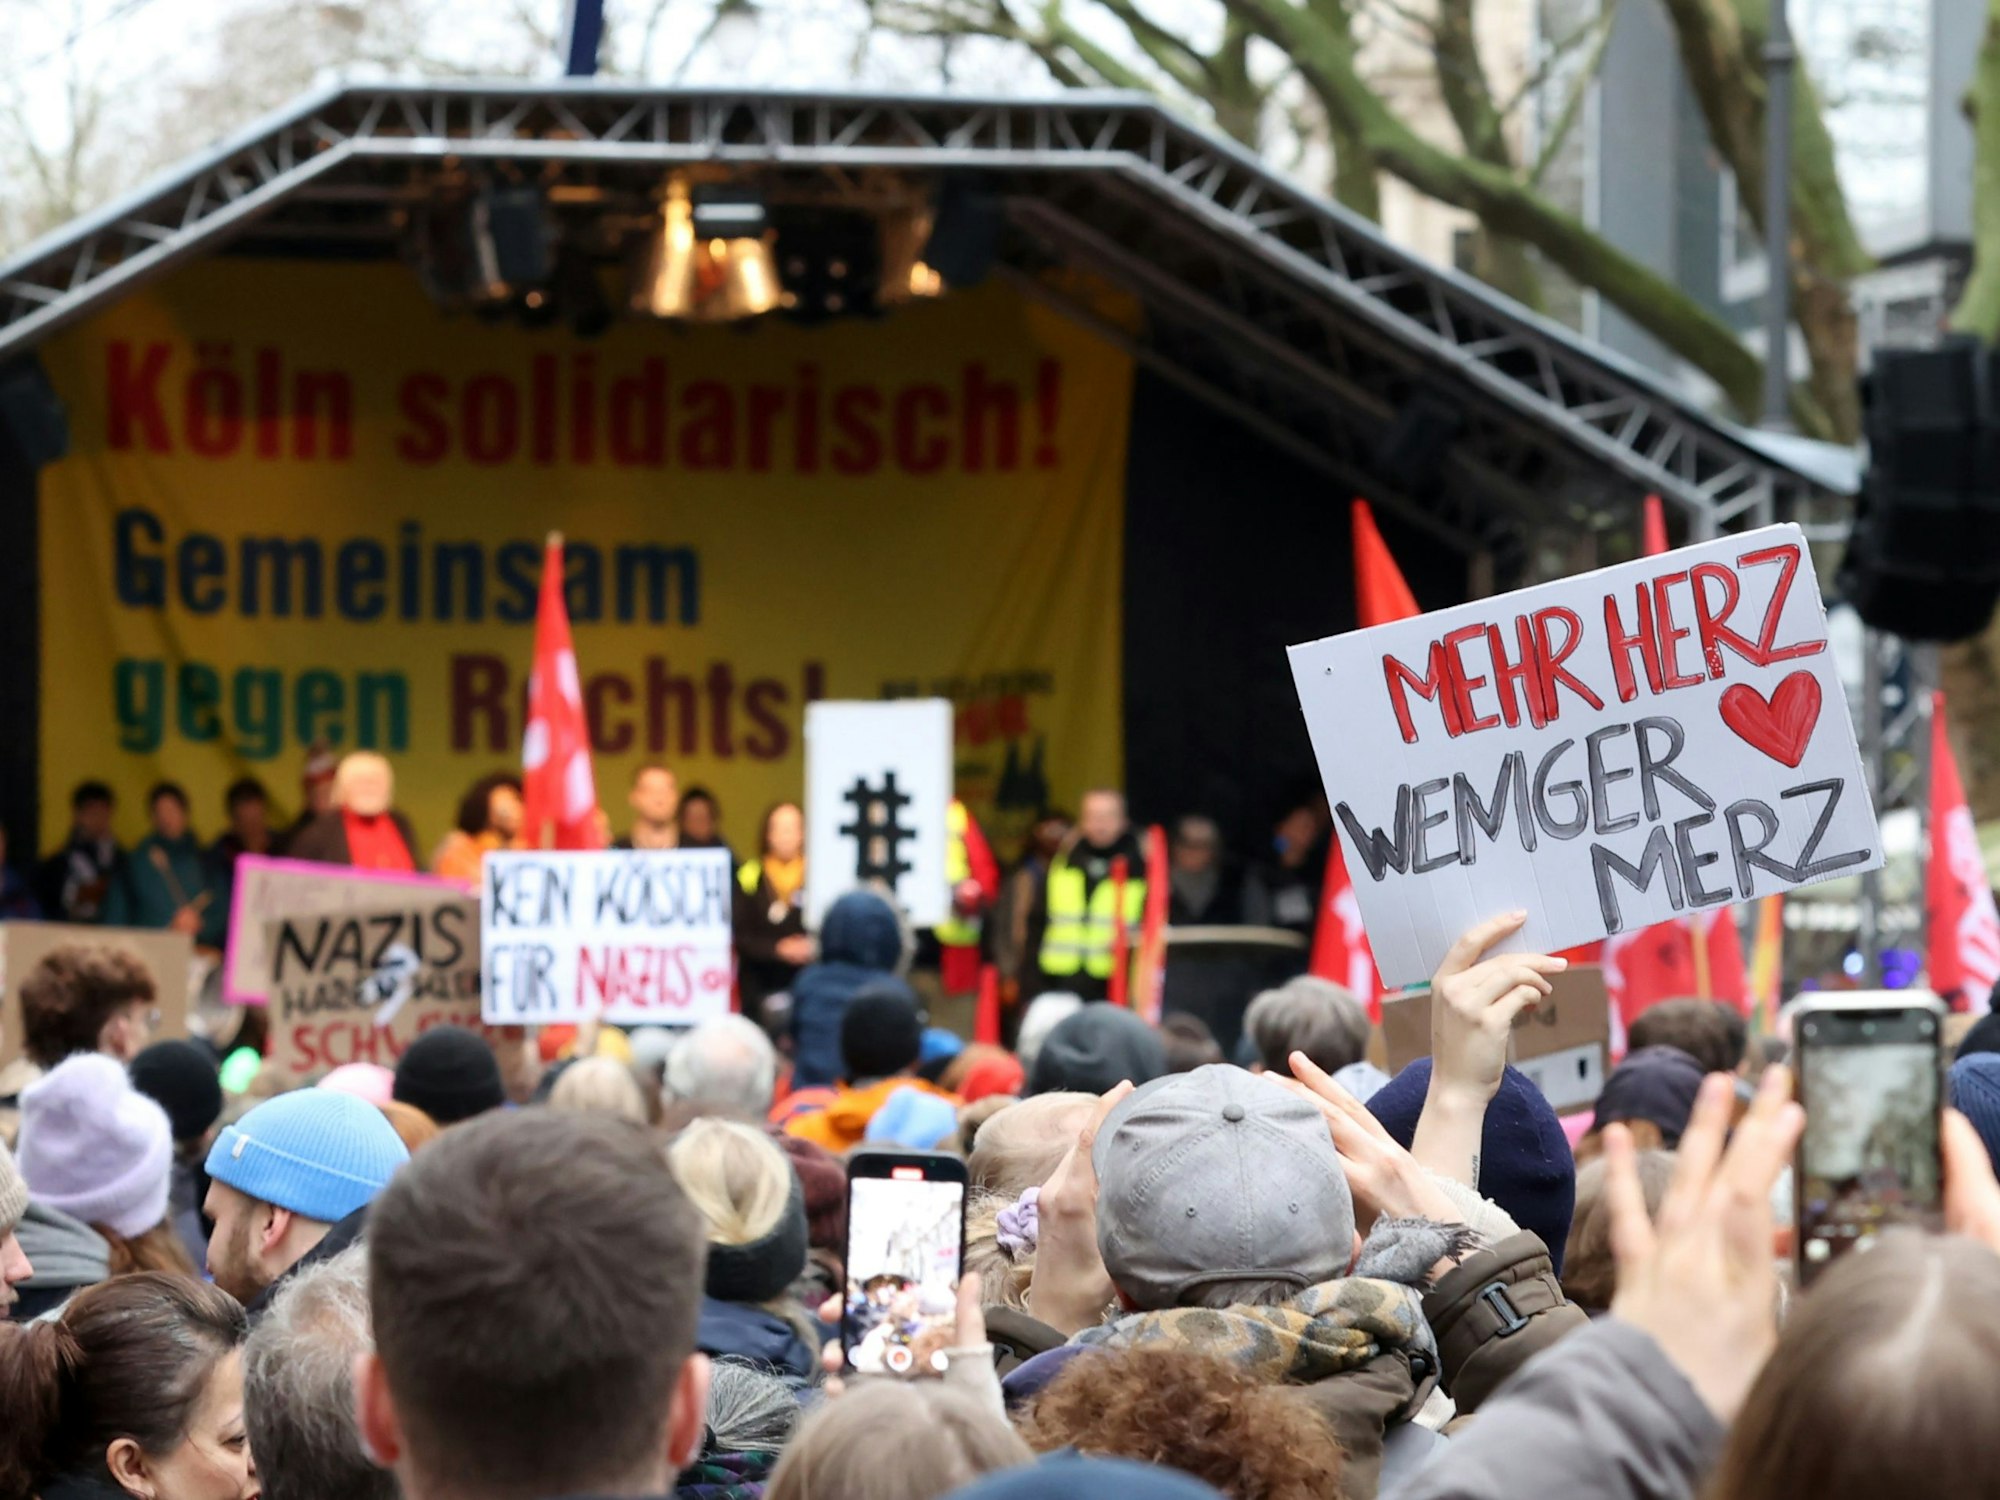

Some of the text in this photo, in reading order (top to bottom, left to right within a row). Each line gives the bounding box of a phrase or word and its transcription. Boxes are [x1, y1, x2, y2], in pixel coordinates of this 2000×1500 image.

[106, 338, 1061, 476] Köln solidarisch!
[113, 507, 700, 628] Gemeinsam
[115, 656, 409, 760] gegen
[449, 652, 828, 761] Rchts
[1383, 544, 1827, 743] MEHR HERZ
[1335, 716, 1716, 882] WENIGER
[1590, 778, 1872, 935] MERZ
[272, 904, 466, 984] NAZIS
[487, 942, 697, 1015] FÜR NAZIS
